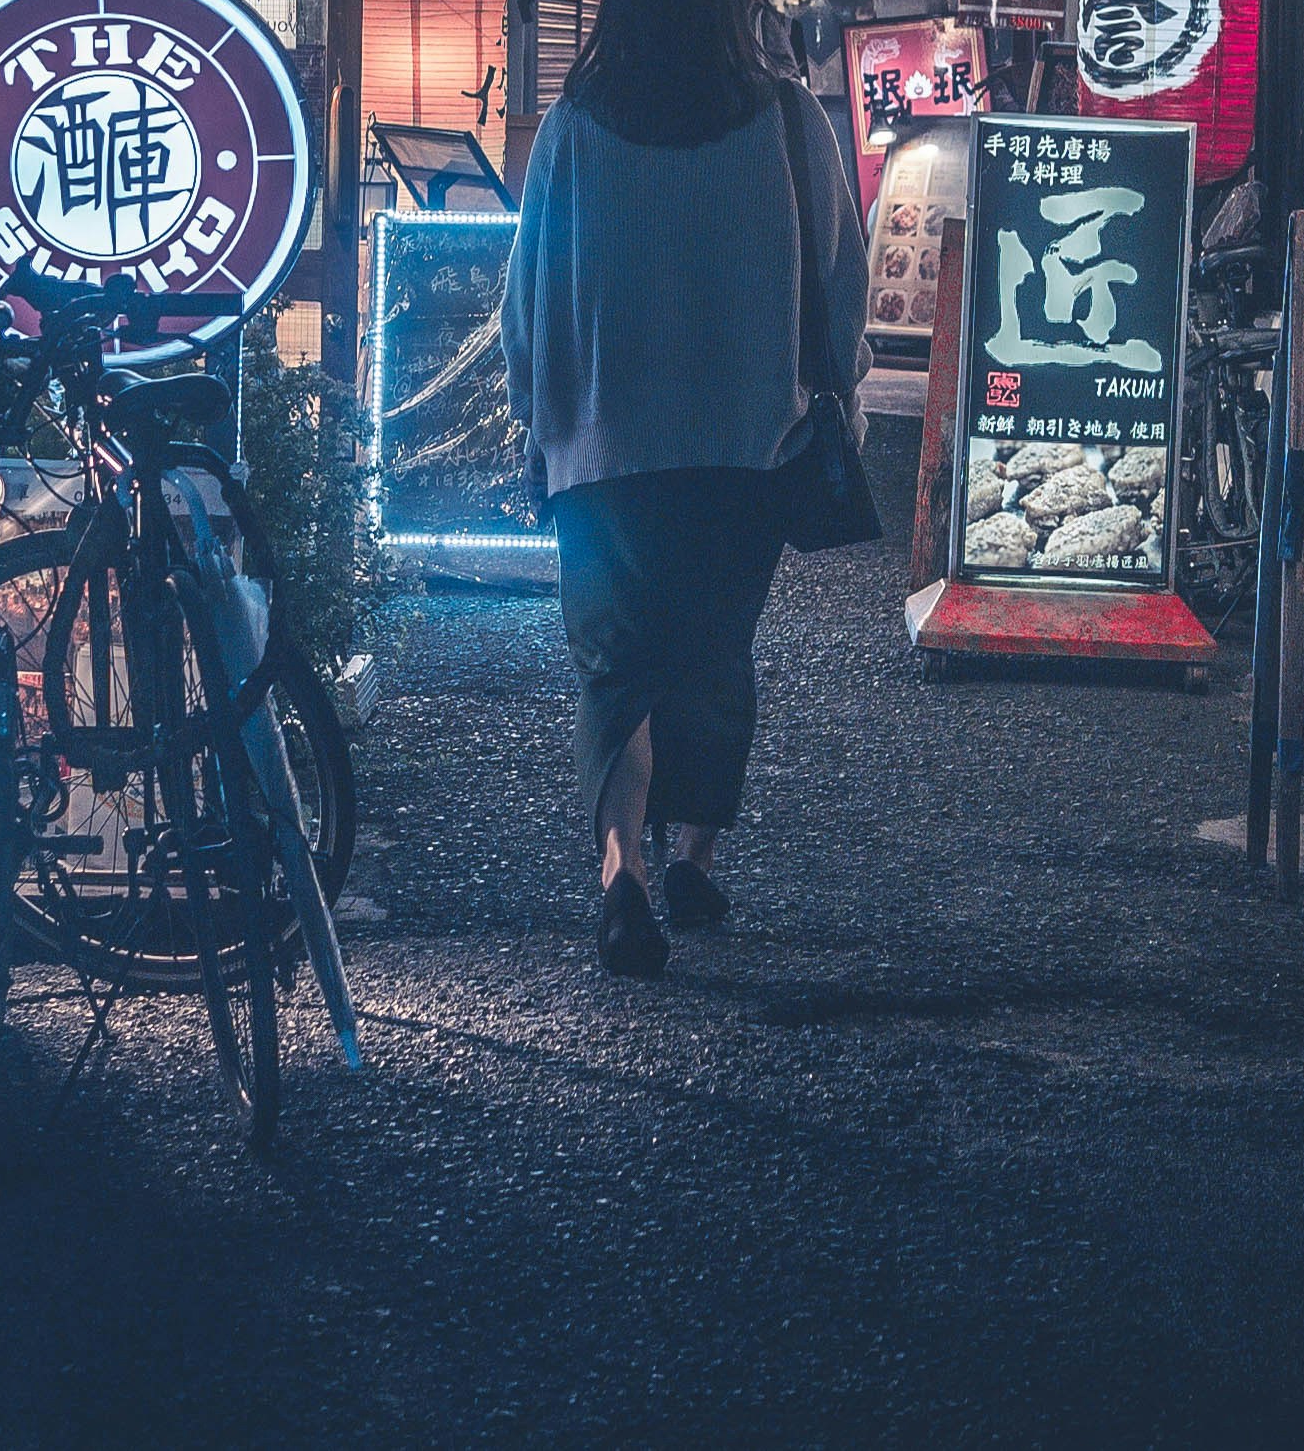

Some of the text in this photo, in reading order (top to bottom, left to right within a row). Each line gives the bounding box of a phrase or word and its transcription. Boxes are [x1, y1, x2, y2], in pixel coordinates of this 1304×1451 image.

[3, 24, 201, 92] THE
[983, 132, 1112, 163] 手羽先唐揚
[1008, 159, 1084, 185] 鳥料理
[985, 186, 1163, 372] 匠
[1094, 377, 1165, 400] TAKUMI
[977, 413, 1015, 436] 新鮮
[1129, 420, 1166, 441] 使用
